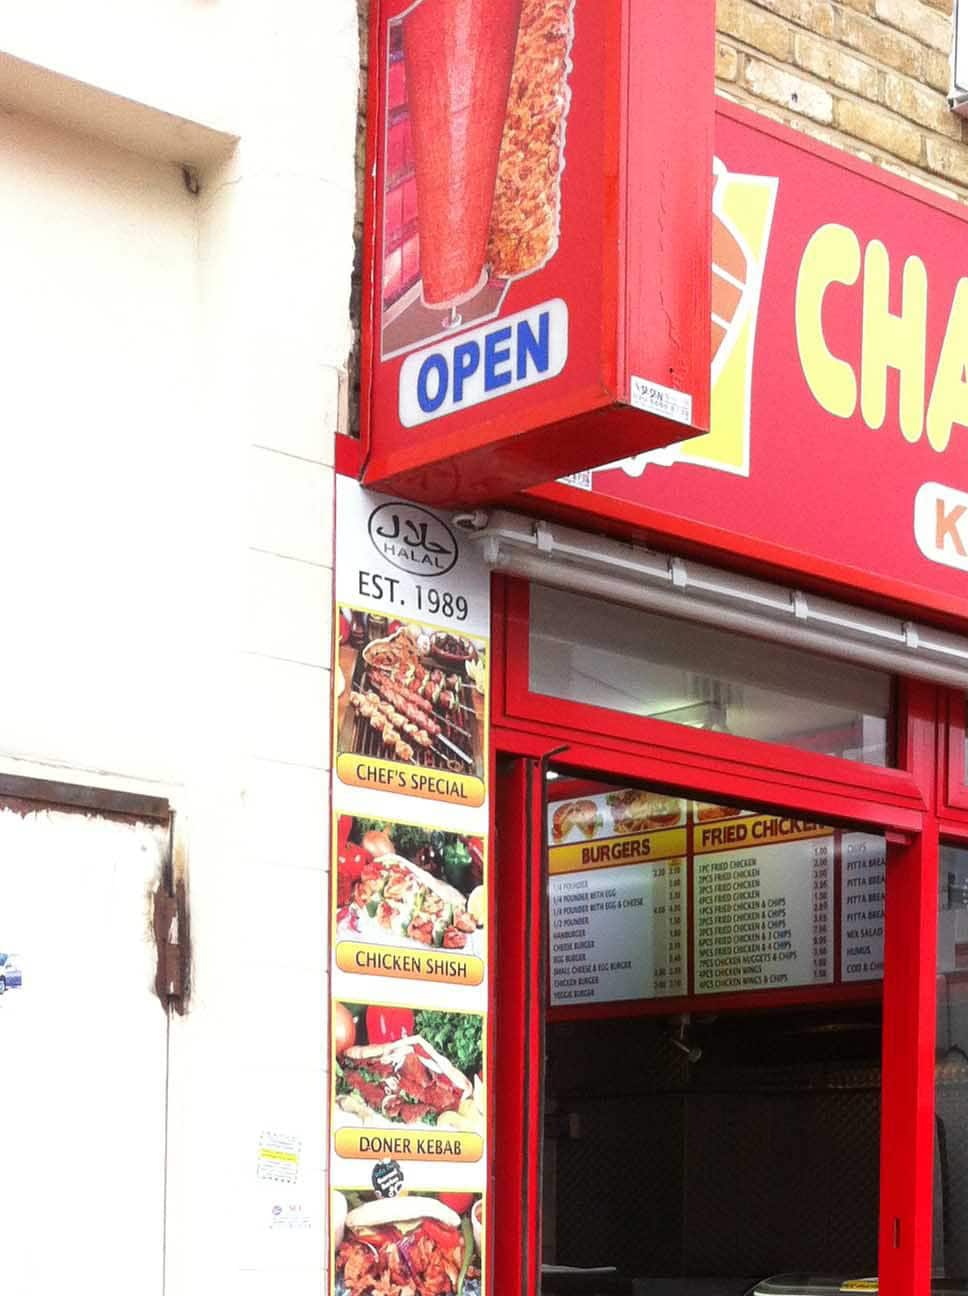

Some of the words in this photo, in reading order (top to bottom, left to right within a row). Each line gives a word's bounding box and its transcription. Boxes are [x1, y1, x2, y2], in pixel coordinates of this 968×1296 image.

[417, 311, 549, 413] OPEN
[384, 543, 444, 570] HALAL
[359, 570, 405, 606] EST.
[415, 585, 468, 621] 1989
[356, 763, 406, 789] CHEF'S
[411, 773, 468, 799] SPECIAL
[702, 824, 748, 847] FRIED
[582, 838, 650, 865] BURGERS
[730, 858, 757, 869] CHICKEN
[733, 868, 760, 880] CHICKEN
[733, 879, 760, 891] CHICKEN
[733, 890, 760, 901] CHICKEN
[355, 950, 421, 974] CHICKEN
[426, 958, 467, 978] SHISH
[359, 1136, 411, 1154] DONER
[416, 1138, 462, 1156] KEBAB
